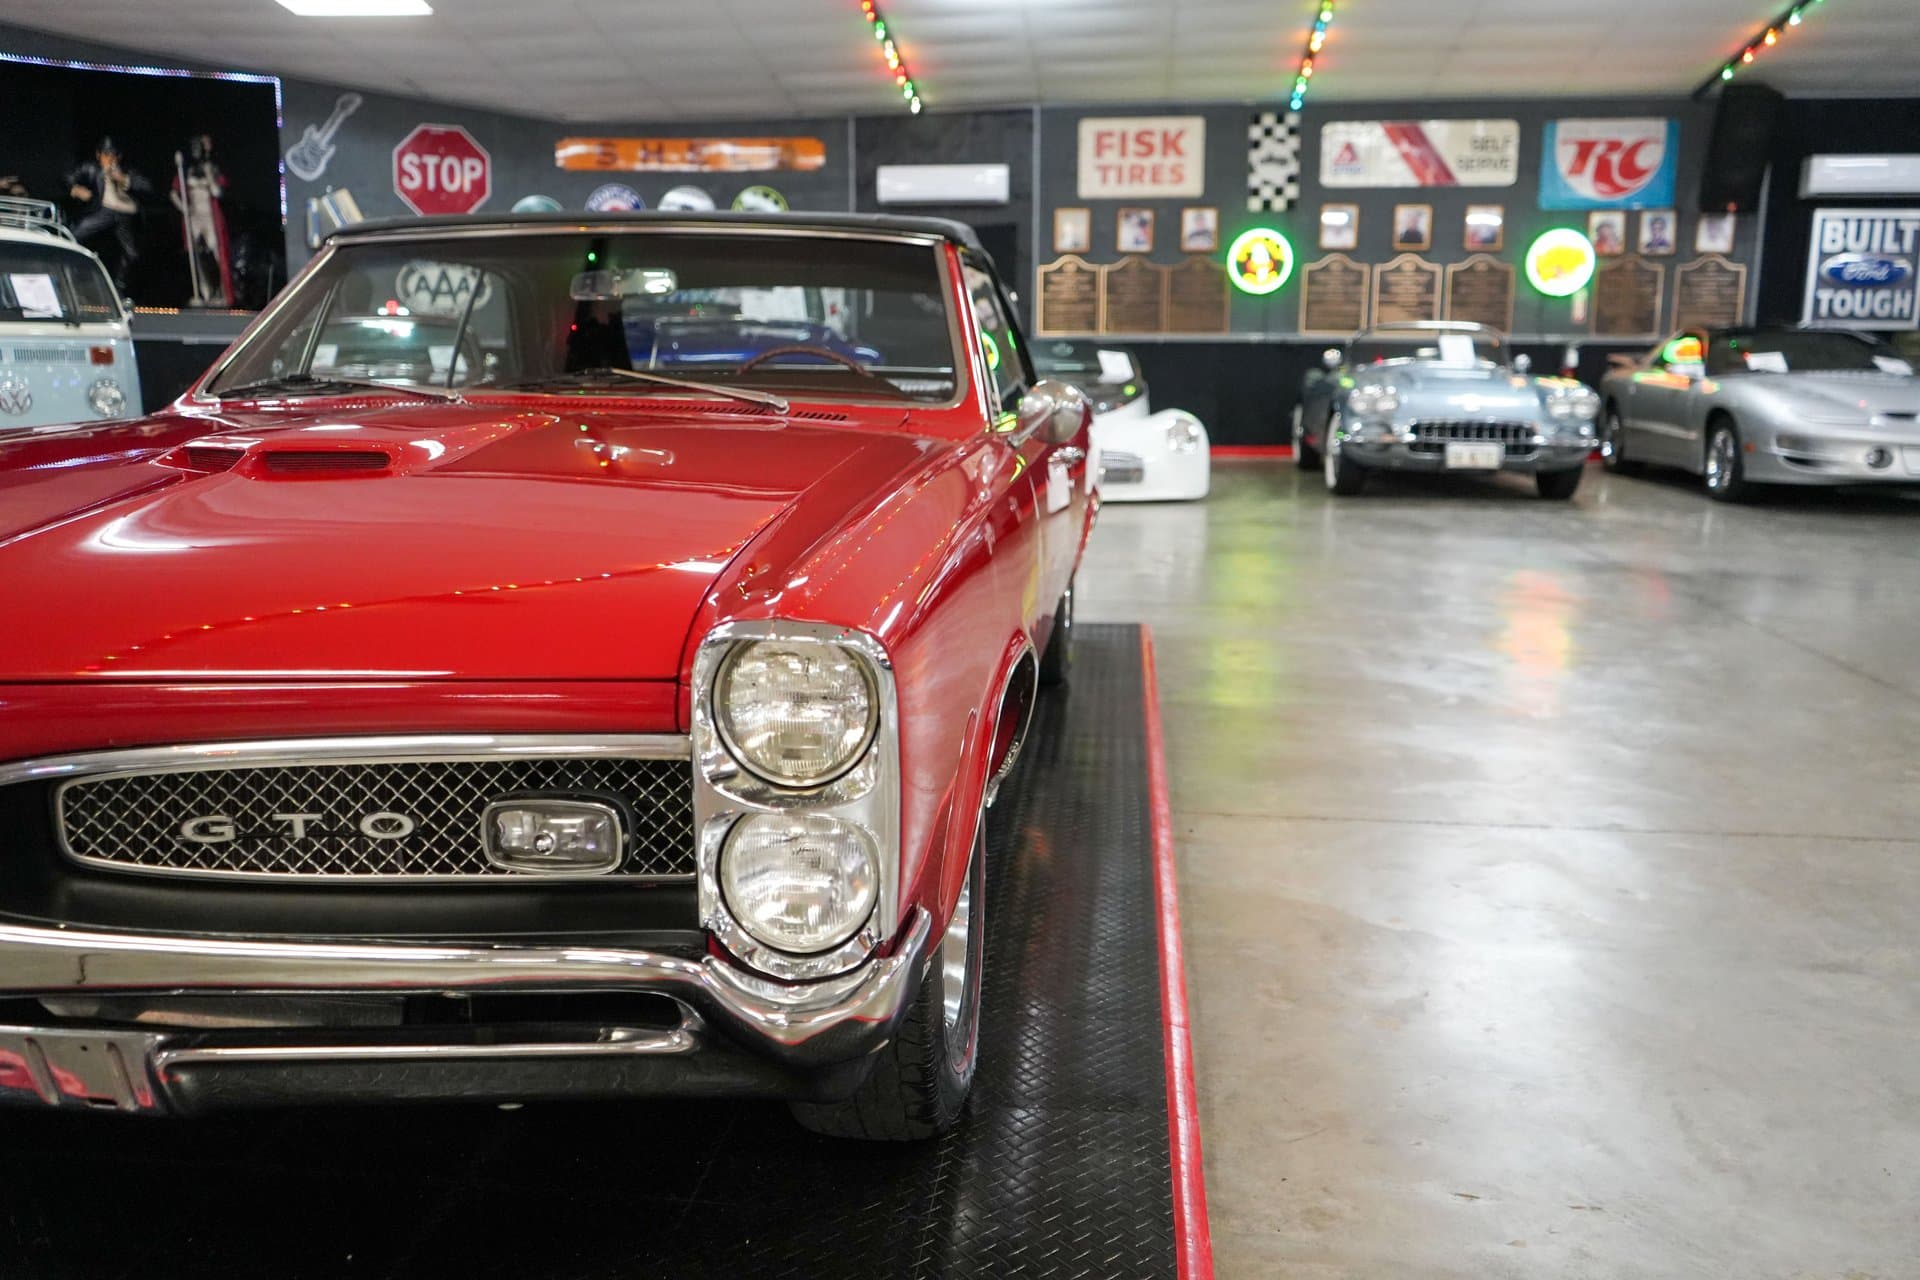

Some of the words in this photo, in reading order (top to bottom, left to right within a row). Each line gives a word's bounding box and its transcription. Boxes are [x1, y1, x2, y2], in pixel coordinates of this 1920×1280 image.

[1094, 128, 1185, 159] FISK
[400, 152, 484, 194] STOP
[1095, 163, 1185, 186] TIRES
[1561, 136, 1660, 195] RC
[1821, 219, 1920, 254] BUILT
[415, 268, 471, 305] AAA
[1841, 261, 1892, 281] Ford
[1816, 288, 1913, 318] TOUGH
